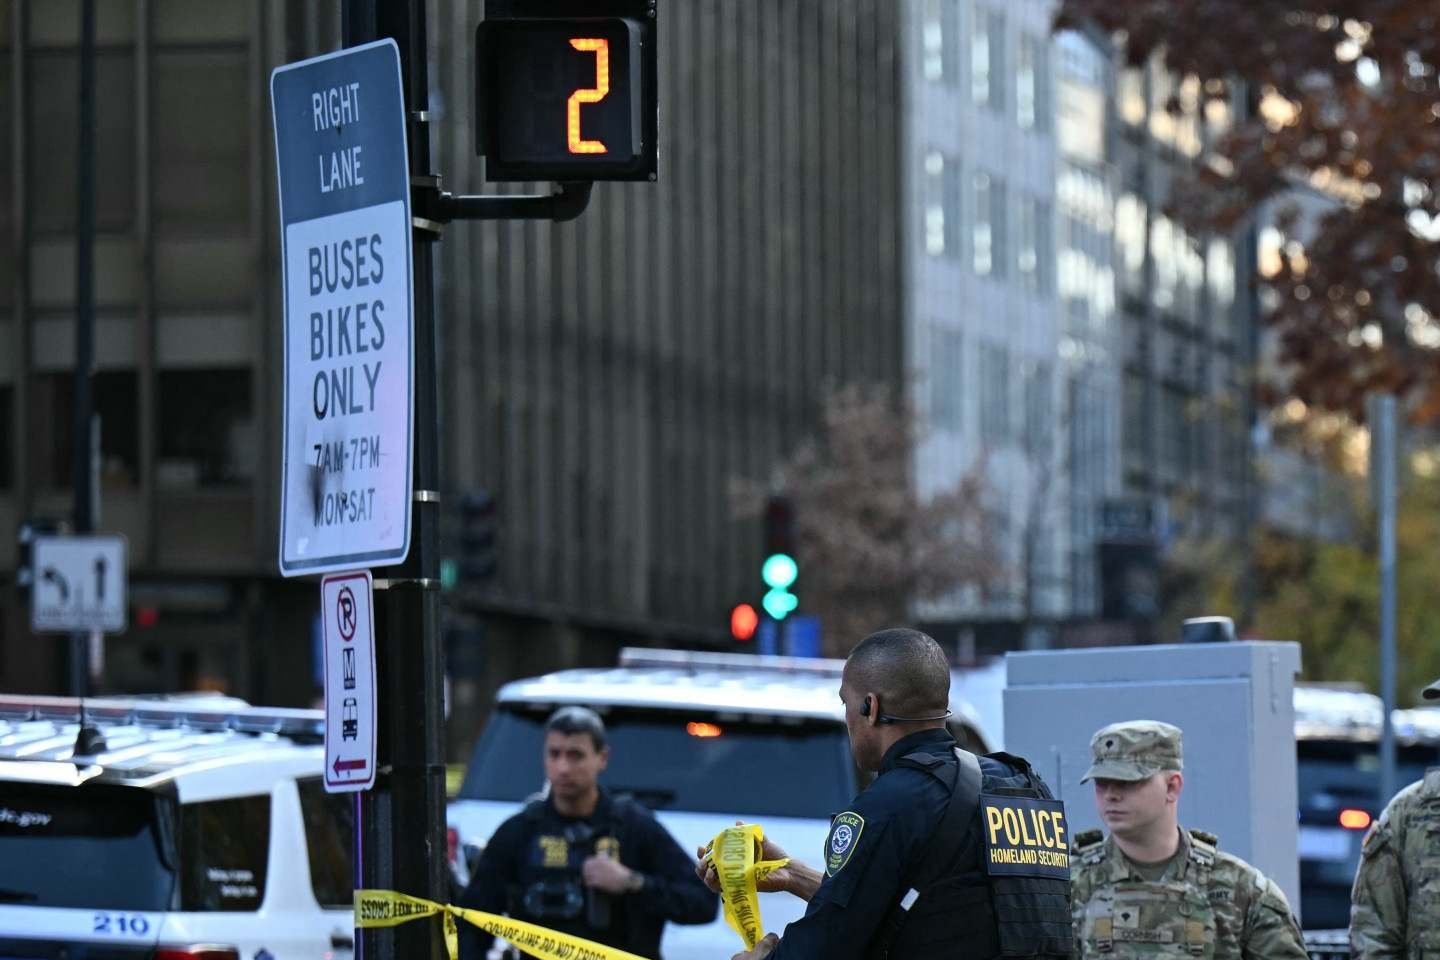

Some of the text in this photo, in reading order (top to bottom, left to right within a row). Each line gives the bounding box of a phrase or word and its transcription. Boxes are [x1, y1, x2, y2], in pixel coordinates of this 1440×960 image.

[312, 82, 360, 131] RIGHT
[568, 38, 609, 154] 2
[320, 145, 364, 193] LANE
[309, 233, 384, 296] BUSES
[310, 299, 385, 361] BIKES
[313, 361, 382, 421] ONLY
[314, 435, 381, 474] 7AM-7PM
[314, 487, 376, 528] MON-SAT
[836, 816, 860, 828] POLICE
[986, 806, 1067, 850] POLICE
[990, 848, 1069, 869] HOMELAND SECURITY
[93, 913, 149, 934] 210
[361, 899, 391, 919] CROSS
[541, 935, 555, 952] DO
[555, 938, 577, 960] NOT
